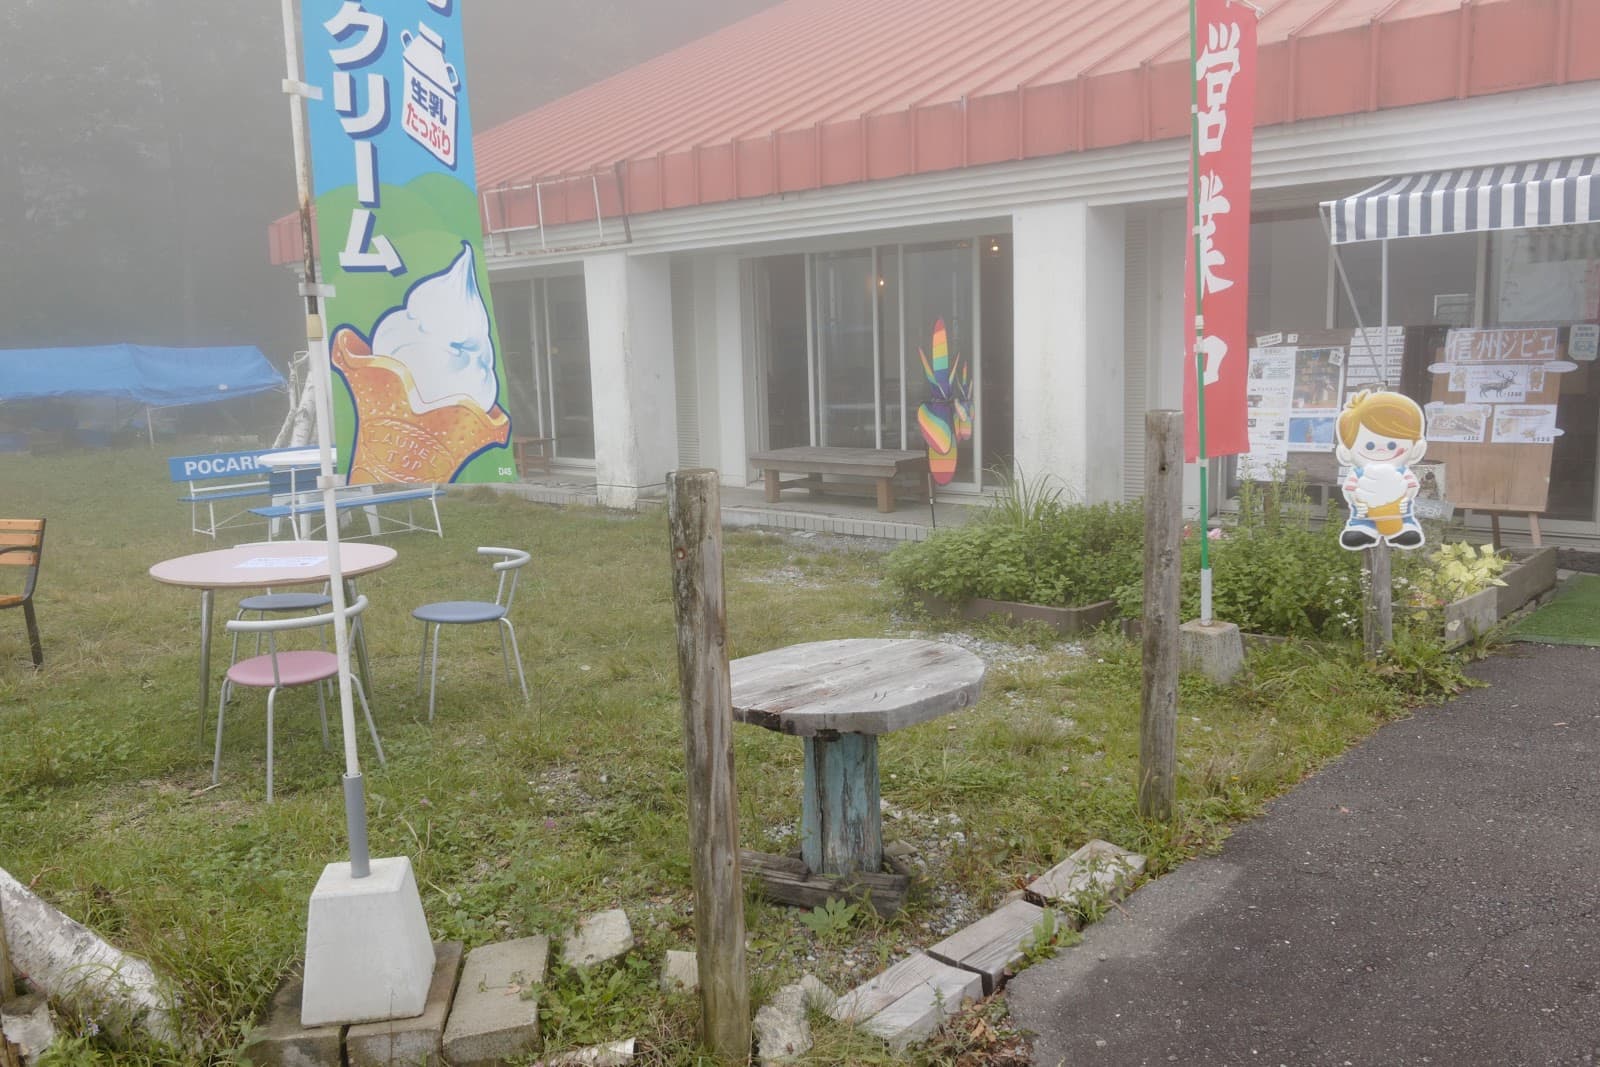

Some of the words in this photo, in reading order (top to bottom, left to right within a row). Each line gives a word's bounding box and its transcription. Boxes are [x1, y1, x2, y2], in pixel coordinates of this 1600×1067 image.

[411, 77, 448, 126] 生乳
[323, 0, 405, 274] クリーム
[406, 102, 451, 156] たっぷり
[367, 430, 438, 467] LAUREL
